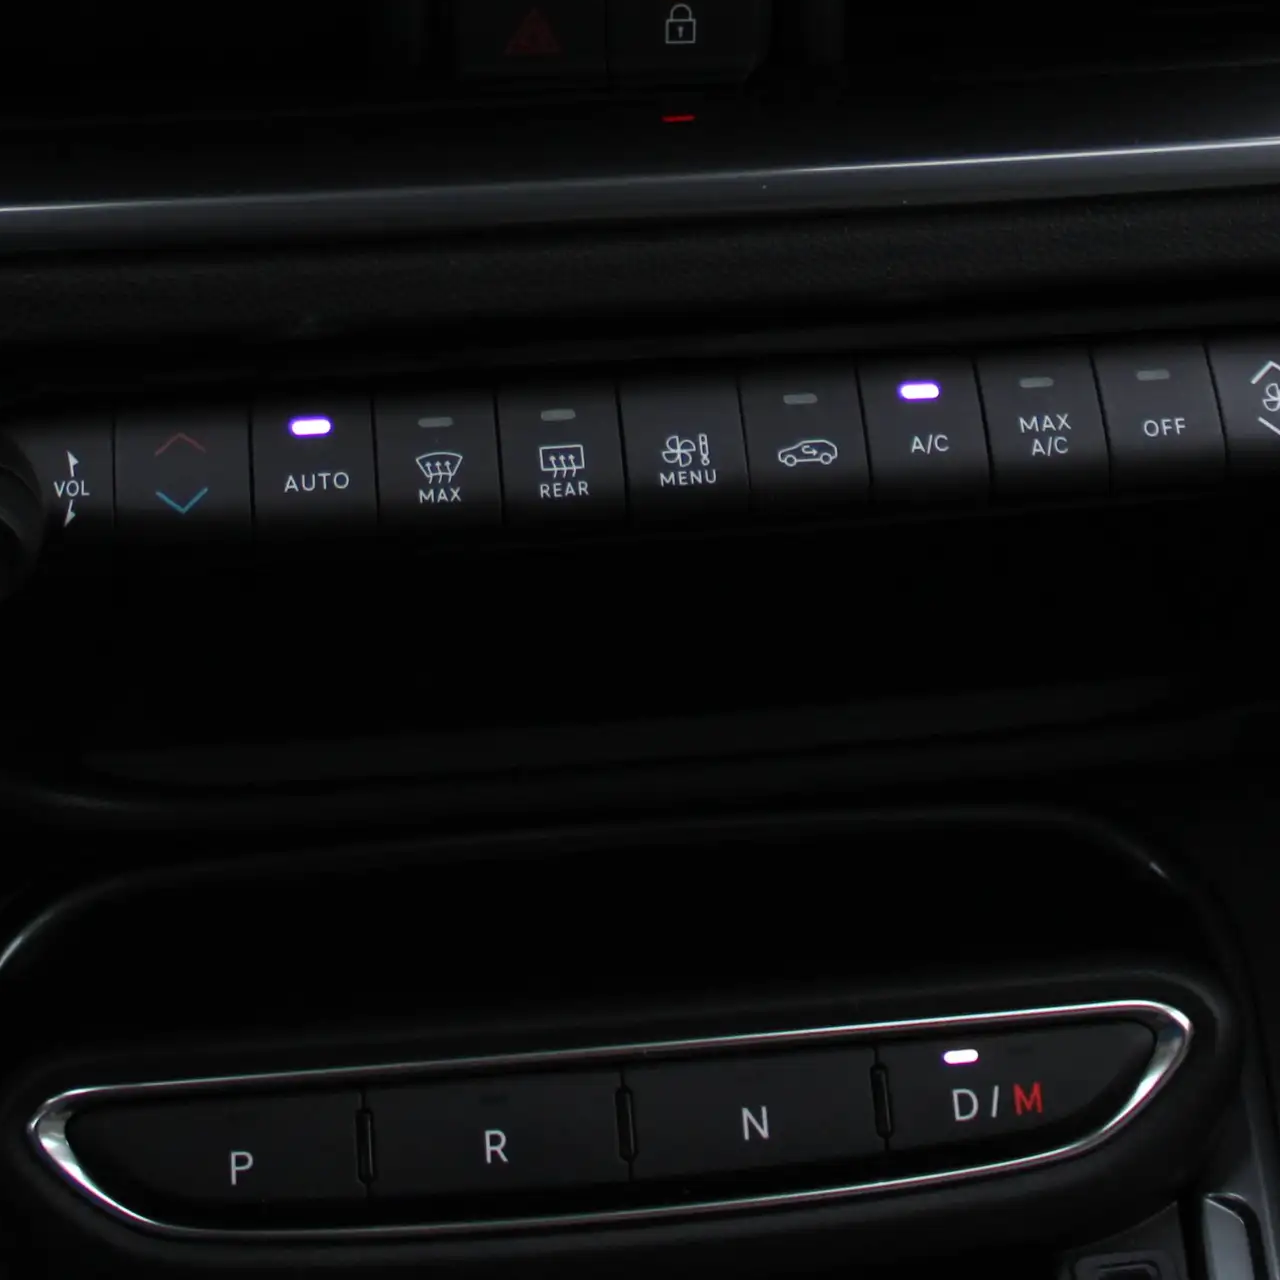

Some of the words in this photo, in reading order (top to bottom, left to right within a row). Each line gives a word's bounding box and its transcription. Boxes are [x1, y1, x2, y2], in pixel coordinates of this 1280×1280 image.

[1019, 413, 1072, 433] MAX
[1143, 417, 1186, 437] OFF
[911, 434, 949, 455] A/C
[1031, 436, 1069, 457] A/C
[284, 471, 350, 493] AUTO
[659, 469, 717, 487] MENU
[53, 480, 90, 498] VOL
[418, 486, 461, 504] MAX
[539, 480, 589, 498] REAR
[741, 1105, 770, 1141] N
[484, 1129, 509, 1164] R
[230, 1150, 254, 1186] P
